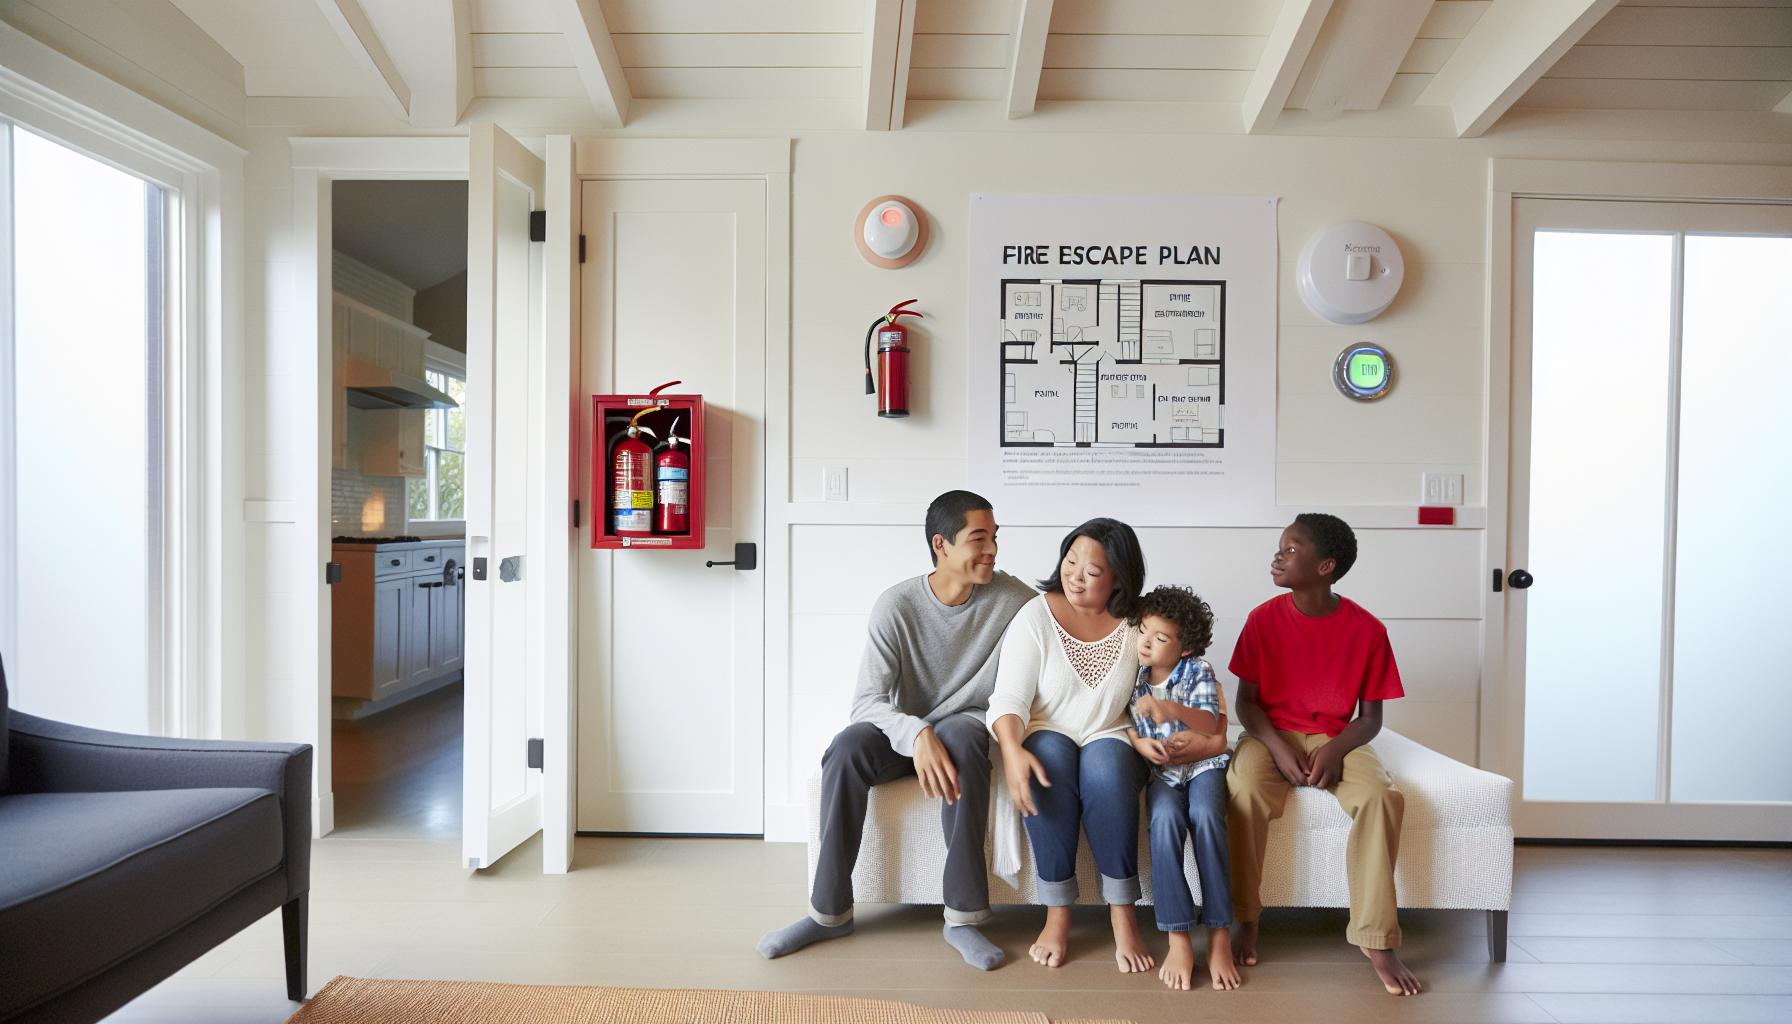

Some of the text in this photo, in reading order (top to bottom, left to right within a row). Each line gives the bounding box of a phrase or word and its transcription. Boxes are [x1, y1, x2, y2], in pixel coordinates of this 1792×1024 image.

[1002, 245, 1221, 266] FIRE ESCAPE PLAN
